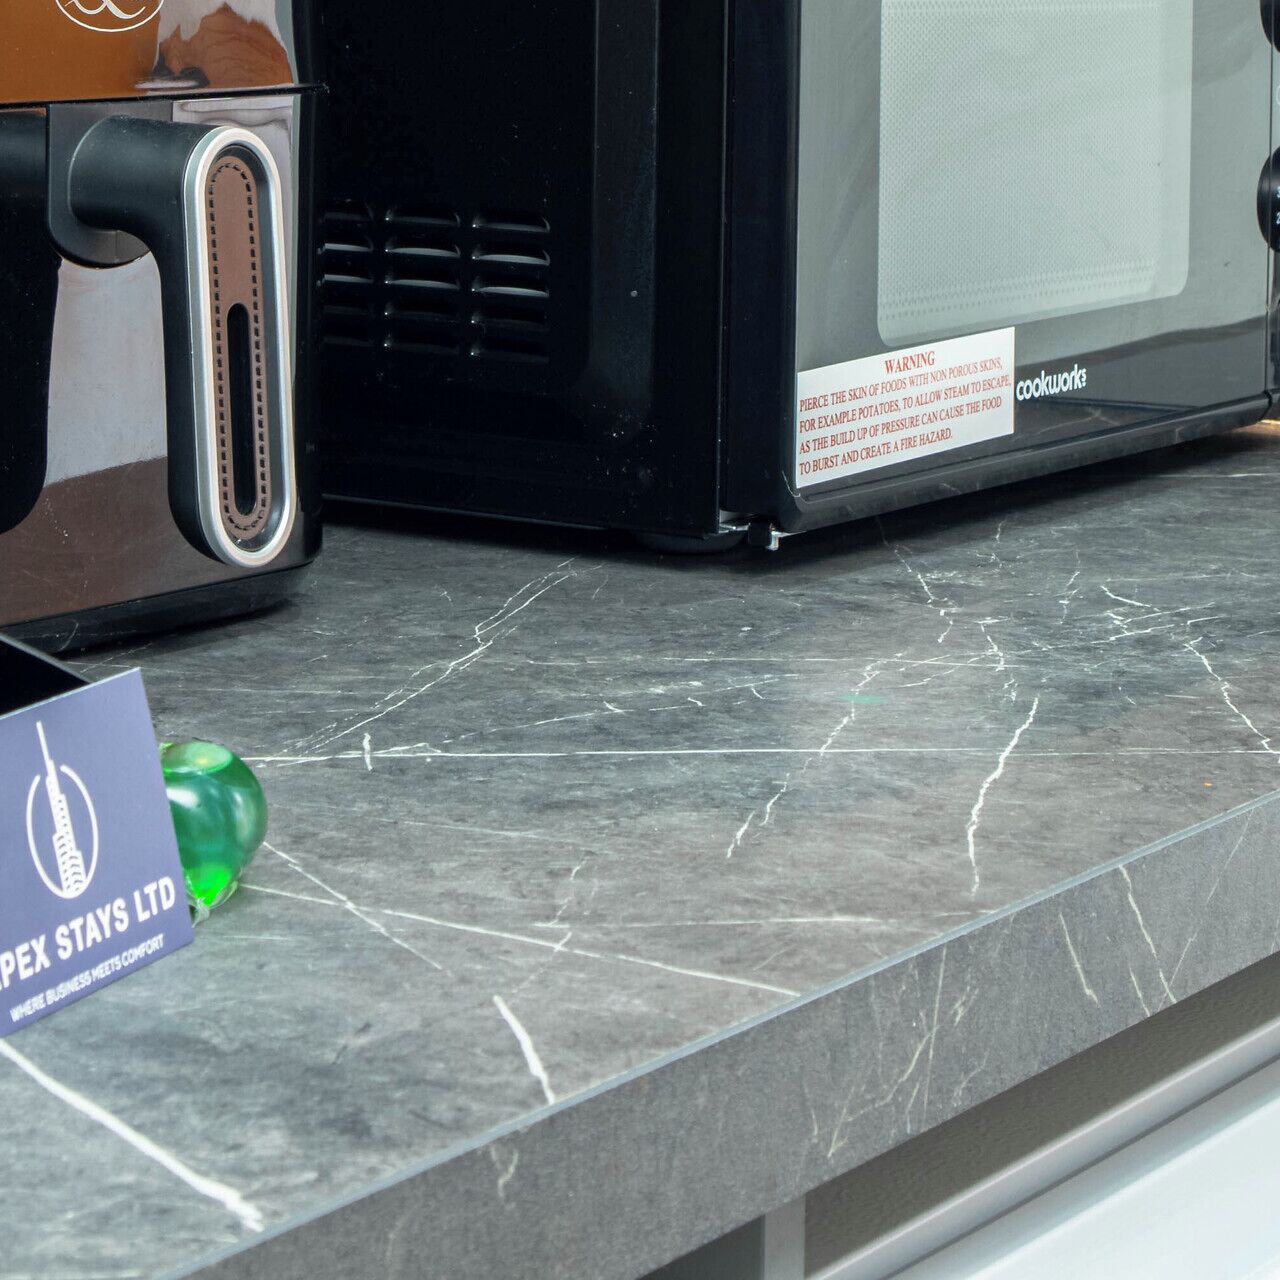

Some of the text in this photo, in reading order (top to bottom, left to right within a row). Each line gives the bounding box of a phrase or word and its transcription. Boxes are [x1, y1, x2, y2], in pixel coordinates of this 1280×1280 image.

[799, 357, 1003, 412] PIERCE THE SKIN OF FOODS WITH NON POROUS SKINS,
[885, 351, 935, 374] WARNING
[1015, 363, 1087, 401] cookworks
[799, 375, 1011, 433] FOR EXAMPLE POTATOES, TO ALLOW STEAM TO ESCAPE,
[799, 396, 1002, 454] AS THE BUILD UP OF PRESSURE CAN CAUSE THE FOOD
[799, 427, 953, 475] TO BURST AND CREATE A FIRE HAZARD.
[55, 897, 129, 960] STAYS
[133, 876, 176, 922] LTD
[9, 933, 164, 1022] WHERE BUSINESS MEETS COMFORT
